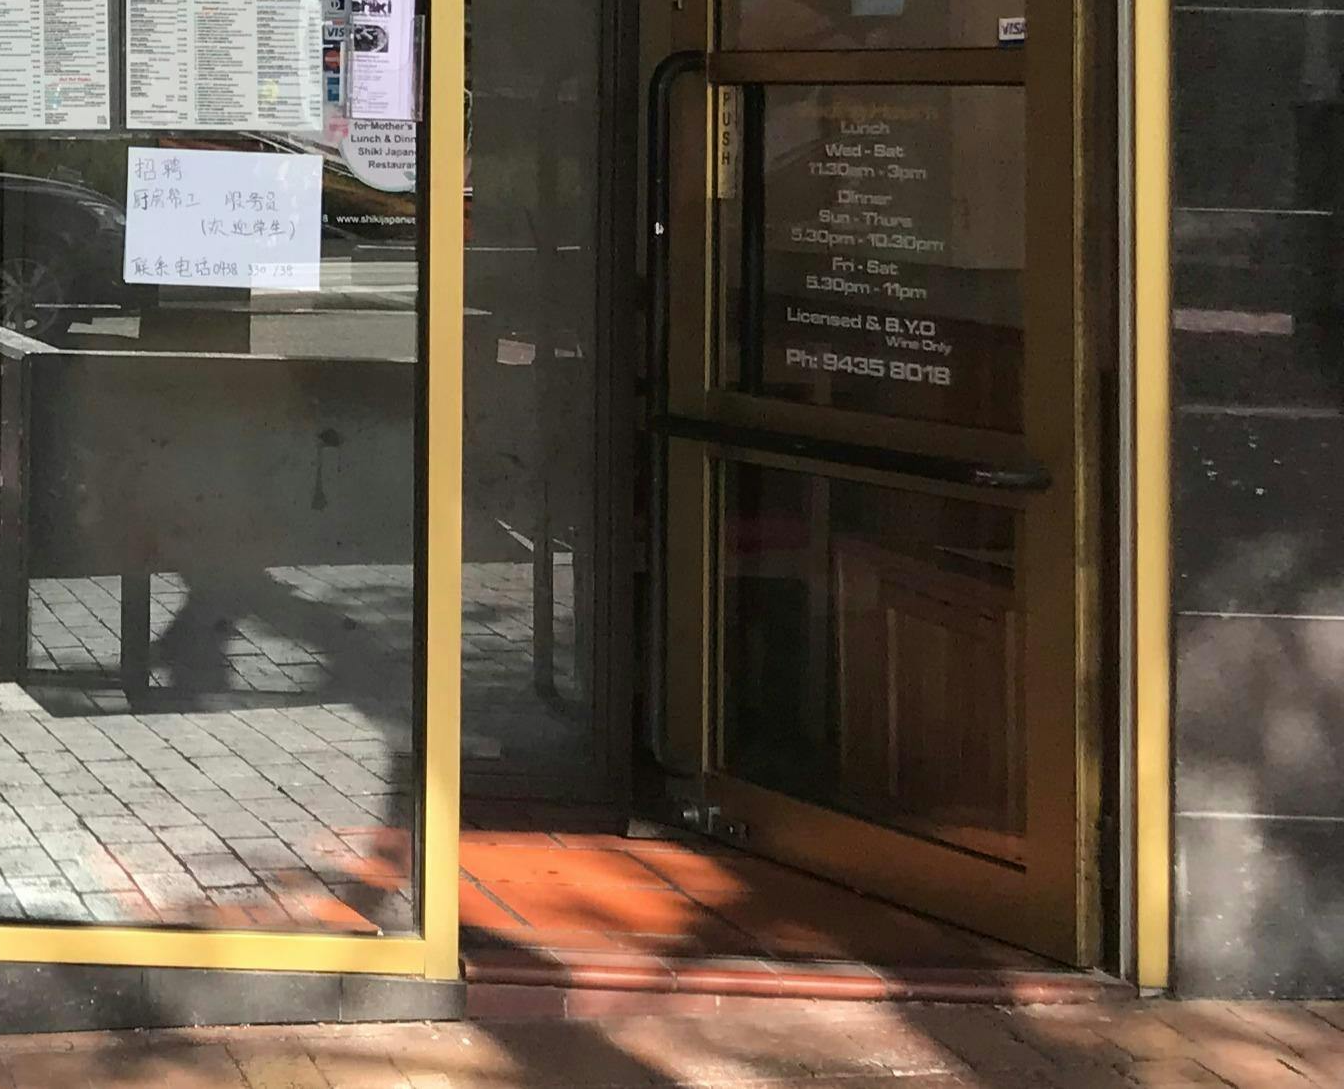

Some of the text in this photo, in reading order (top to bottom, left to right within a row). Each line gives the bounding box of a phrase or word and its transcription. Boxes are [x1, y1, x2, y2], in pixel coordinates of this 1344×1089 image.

[353, 121, 369, 130] for
[371, 121, 412, 130] Mother's
[722, 92, 731, 165] PUSH
[841, 121, 890, 134] Lunch
[351, 135, 416, 143] Lunch & Dinn
[358, 147, 416, 157] Shiki Japan
[825, 144, 862, 157] Wed
[874, 144, 905, 158] Sat
[134, 158, 182, 181] 招聘
[887, 165, 927, 181] 3pm
[838, 189, 892, 205] Dinner
[818, 210, 850, 223] Sun
[862, 211, 912, 228] Thurs
[791, 229, 856, 246] 5.30pm
[868, 233, 944, 253] 10.30pm
[832, 257, 854, 272] Fri
[866, 260, 899, 276] Sat
[806, 275, 870, 295] 5.30pm
[882, 282, 927, 300] 11pm
[787, 307, 936, 336] Licensed & B.Y.O
[885, 336, 953, 356] Wine Only
[786, 348, 951, 385] Ph: 9435 8018
